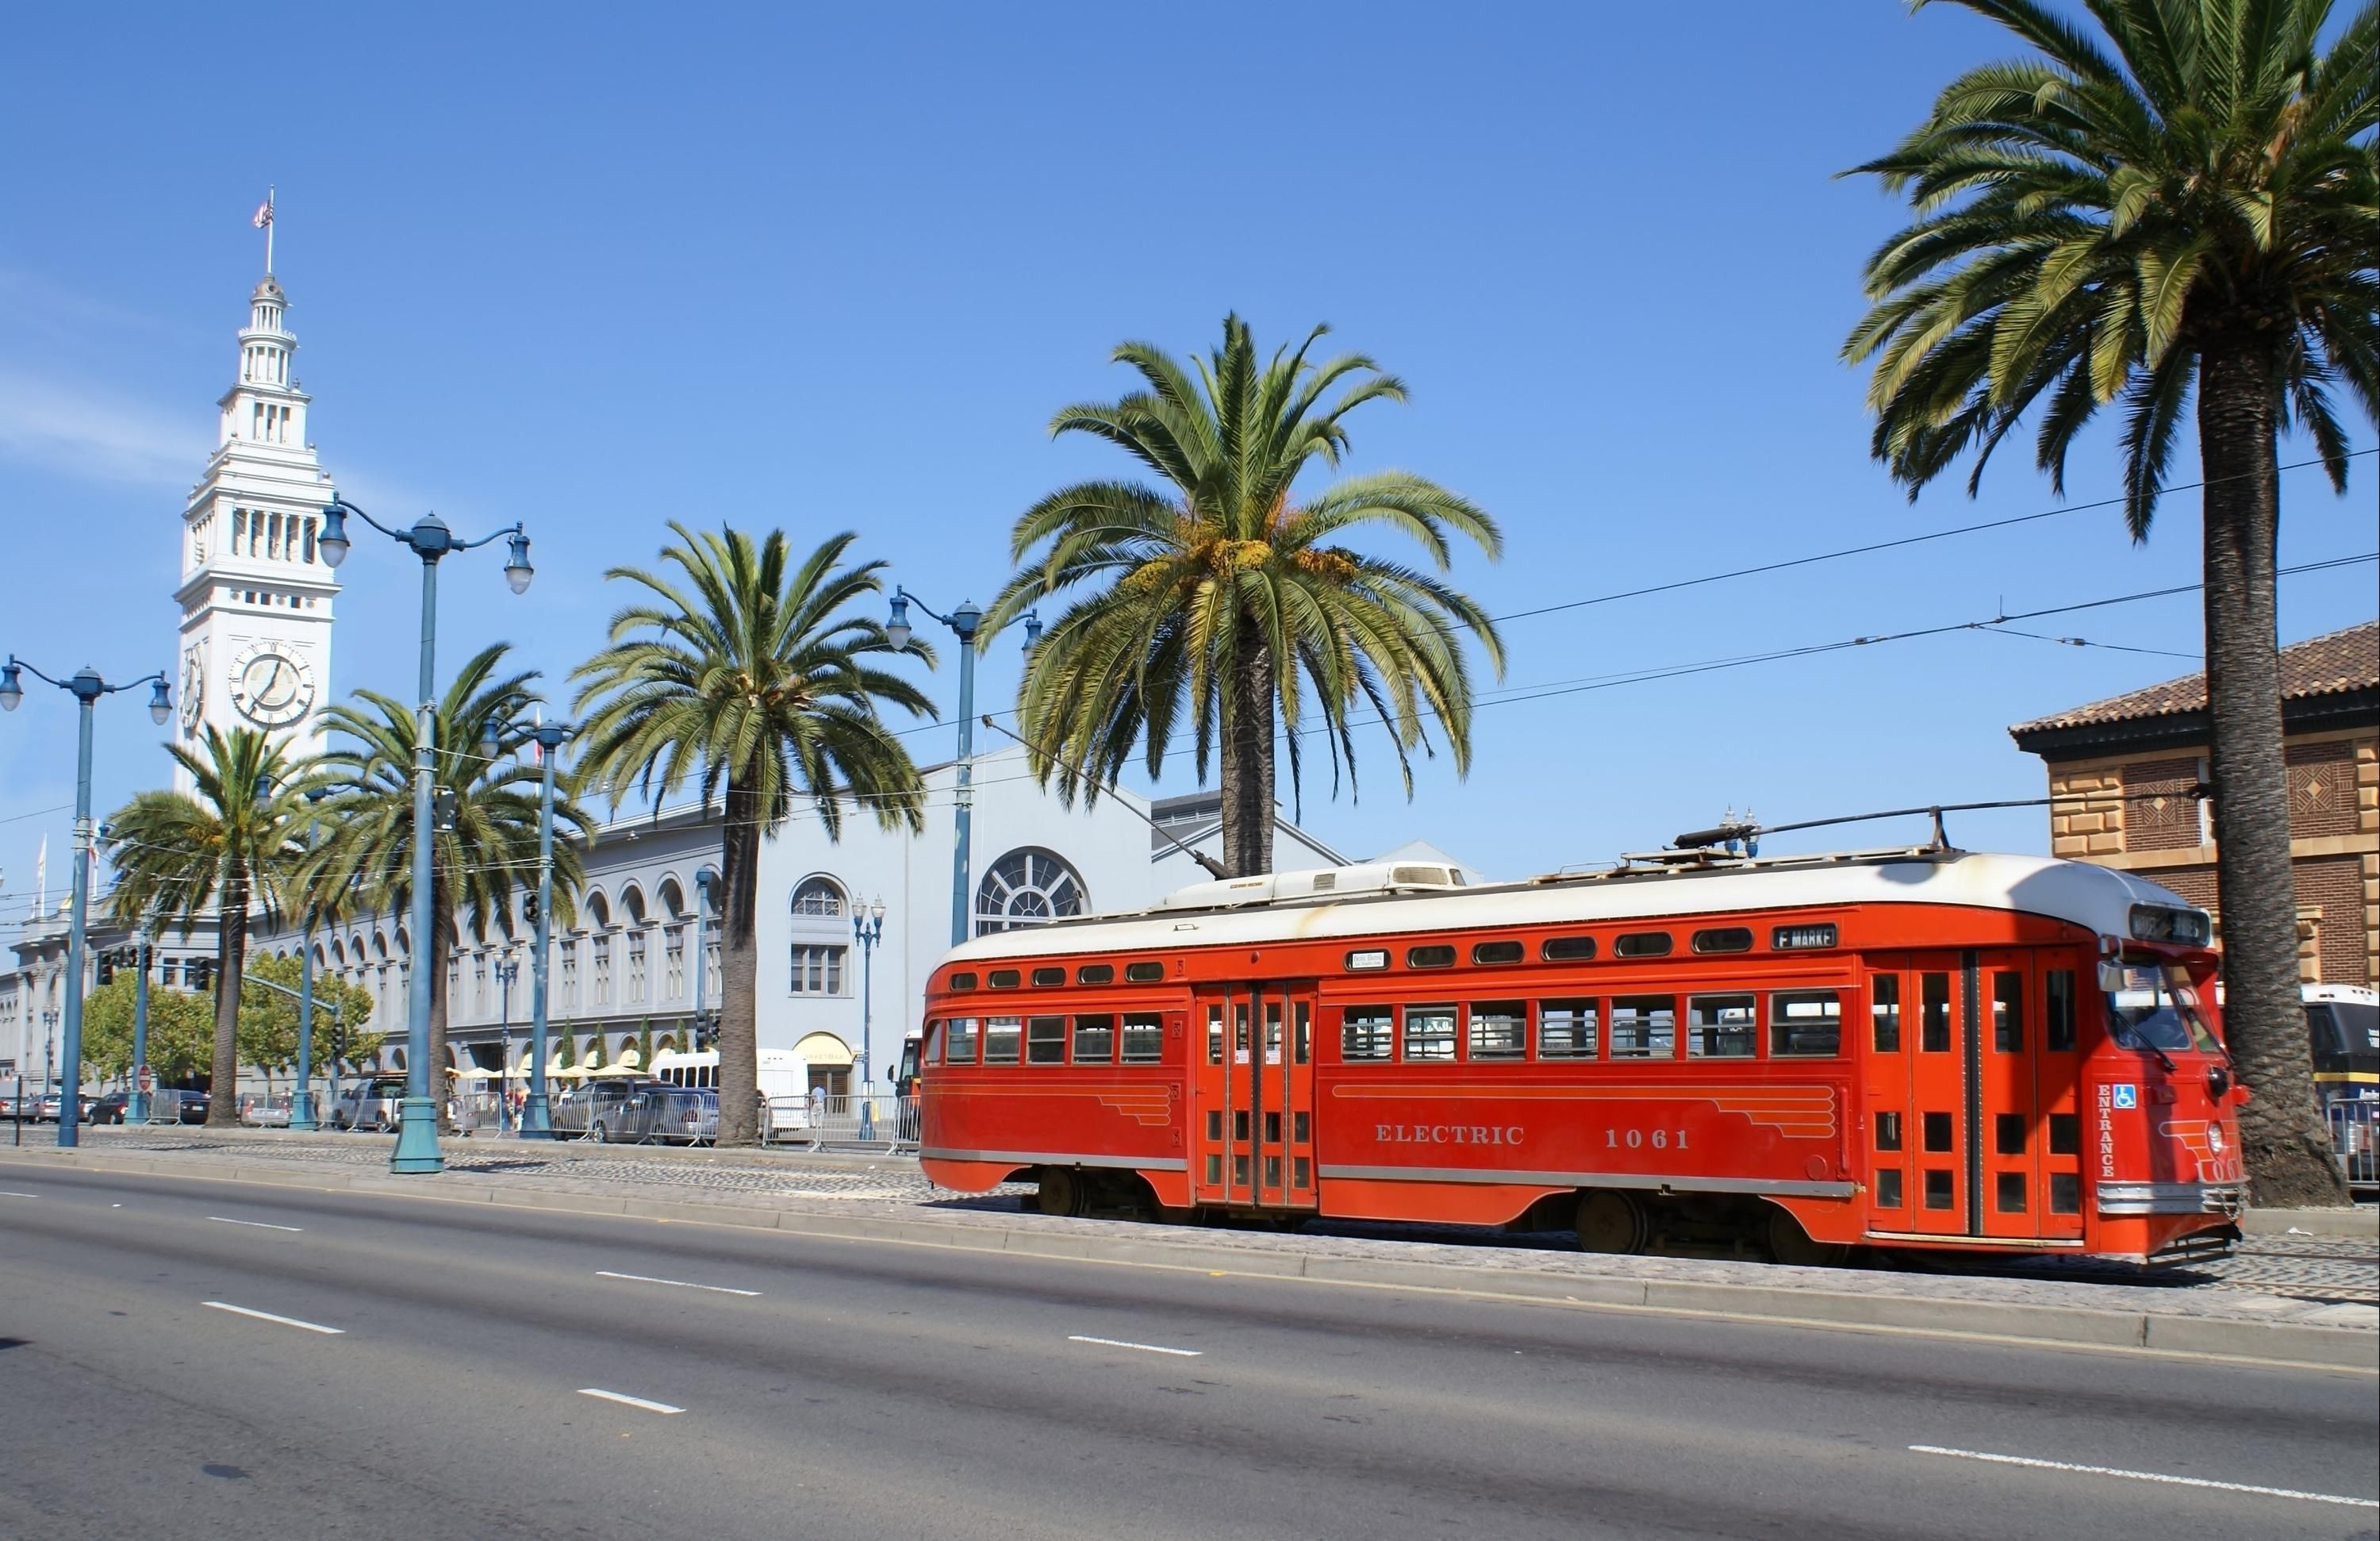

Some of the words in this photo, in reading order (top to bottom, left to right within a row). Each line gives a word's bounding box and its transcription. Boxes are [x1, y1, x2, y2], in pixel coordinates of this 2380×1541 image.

[1779, 931, 1787, 947] F
[1376, 1124, 1524, 1145] ELECTRIC
[1606, 1129, 1689, 1149] 1061
[2098, 1085, 2114, 1177] ENTRANCE
